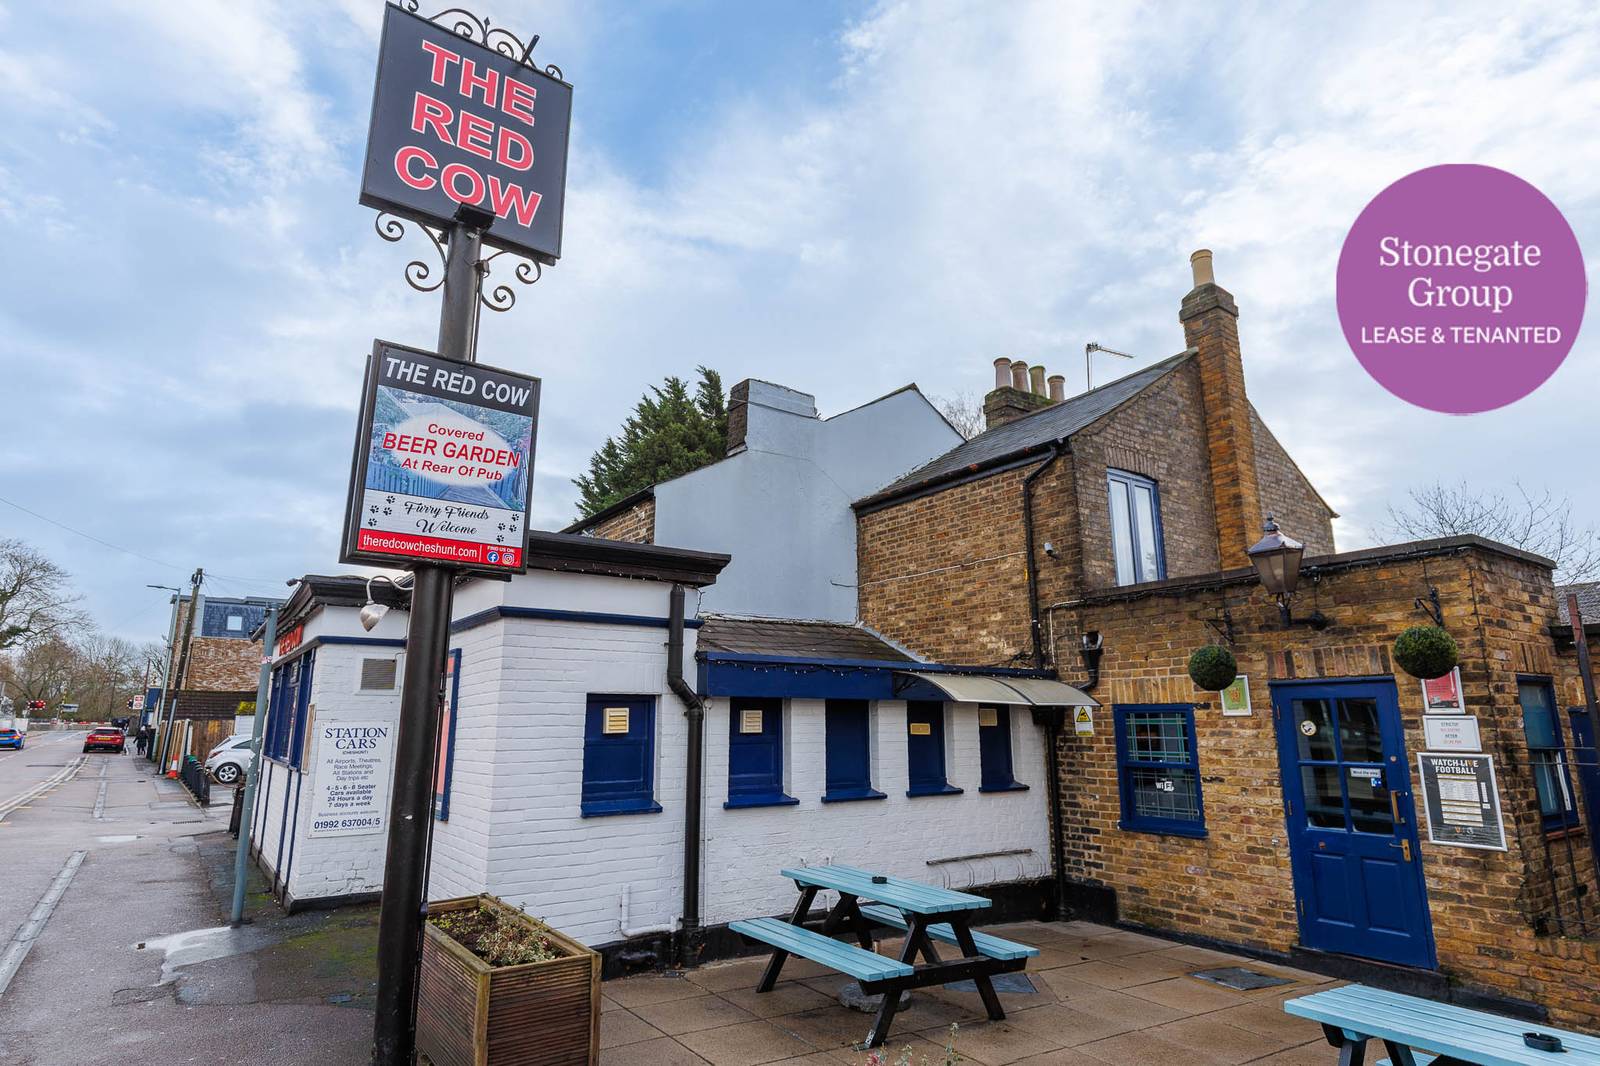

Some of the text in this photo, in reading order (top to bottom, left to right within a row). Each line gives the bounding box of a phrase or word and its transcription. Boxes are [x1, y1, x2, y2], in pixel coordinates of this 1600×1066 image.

[422, 39, 537, 127] THE
[411, 91, 535, 172] RED
[394, 145, 543, 229] COW
[386, 357, 531, 407] THE RED COW
[428, 423, 485, 442] Covered
[383, 432, 520, 468] BEER GARDEN
[402, 458, 503, 481] At Rear Of Pub
[404, 501, 490, 520] Furry Friends
[416, 518, 478, 534] Welcome
[363, 534, 478, 558] theredcowcheshunt.com
[325, 727, 388, 738] STATION
[335, 738, 377, 749] CARS
[1435, 765, 1477, 775] FOOTBALL
[314, 817, 381, 829] 01992 637004/5
